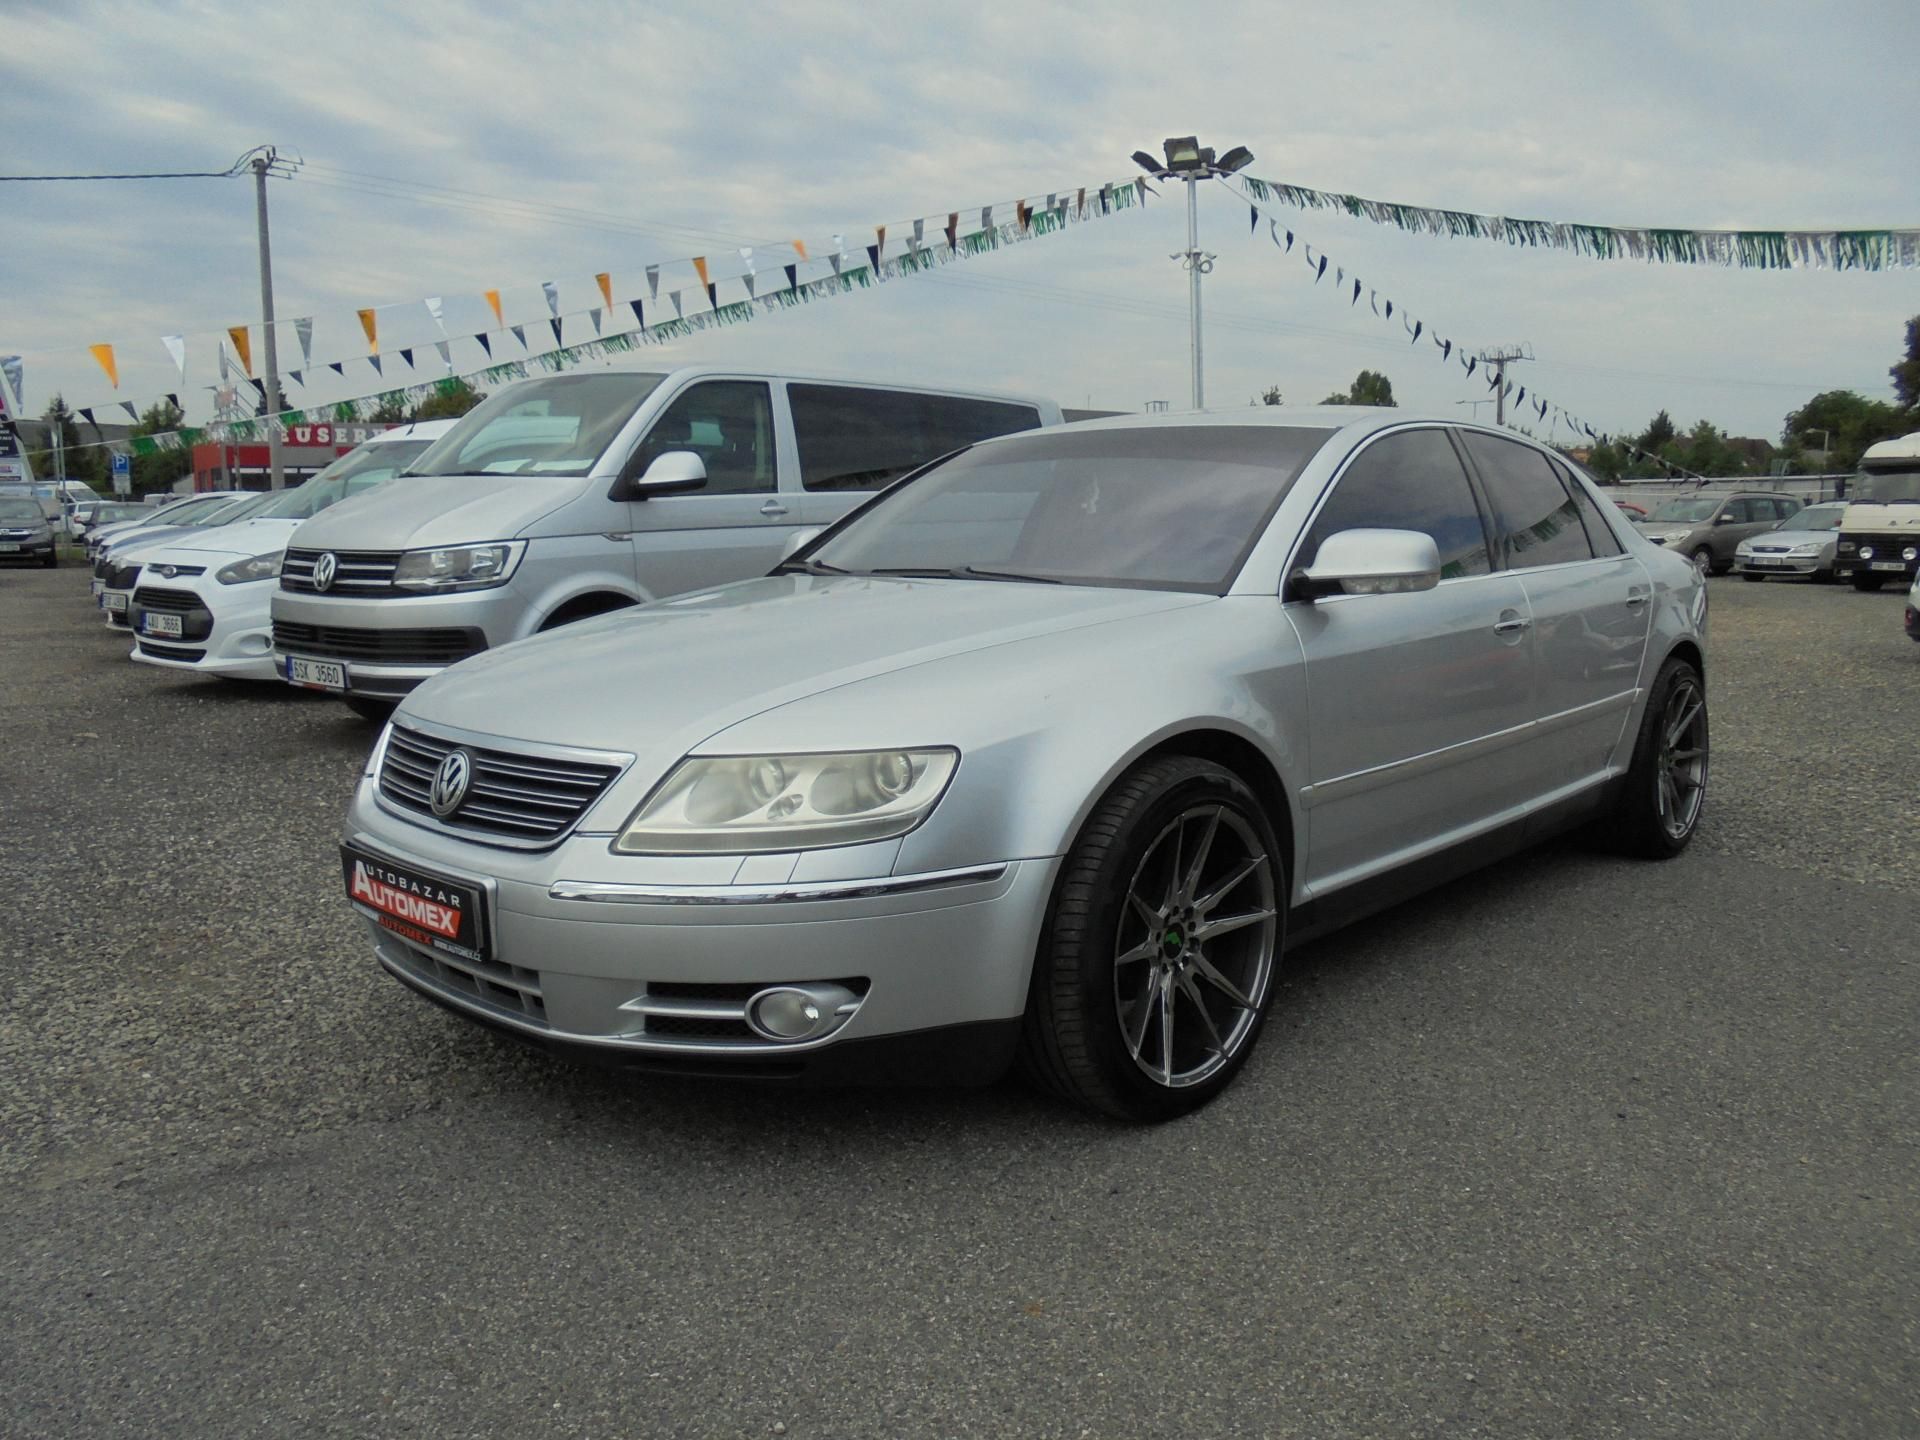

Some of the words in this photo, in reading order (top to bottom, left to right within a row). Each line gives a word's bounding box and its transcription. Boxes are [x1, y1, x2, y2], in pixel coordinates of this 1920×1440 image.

[115, 456, 126, 469] P
[294, 661, 310, 680] 6SK
[315, 664, 339, 684] 3560
[354, 859, 456, 934] AUTOMEX
[379, 916, 432, 945] AUTOMEX
